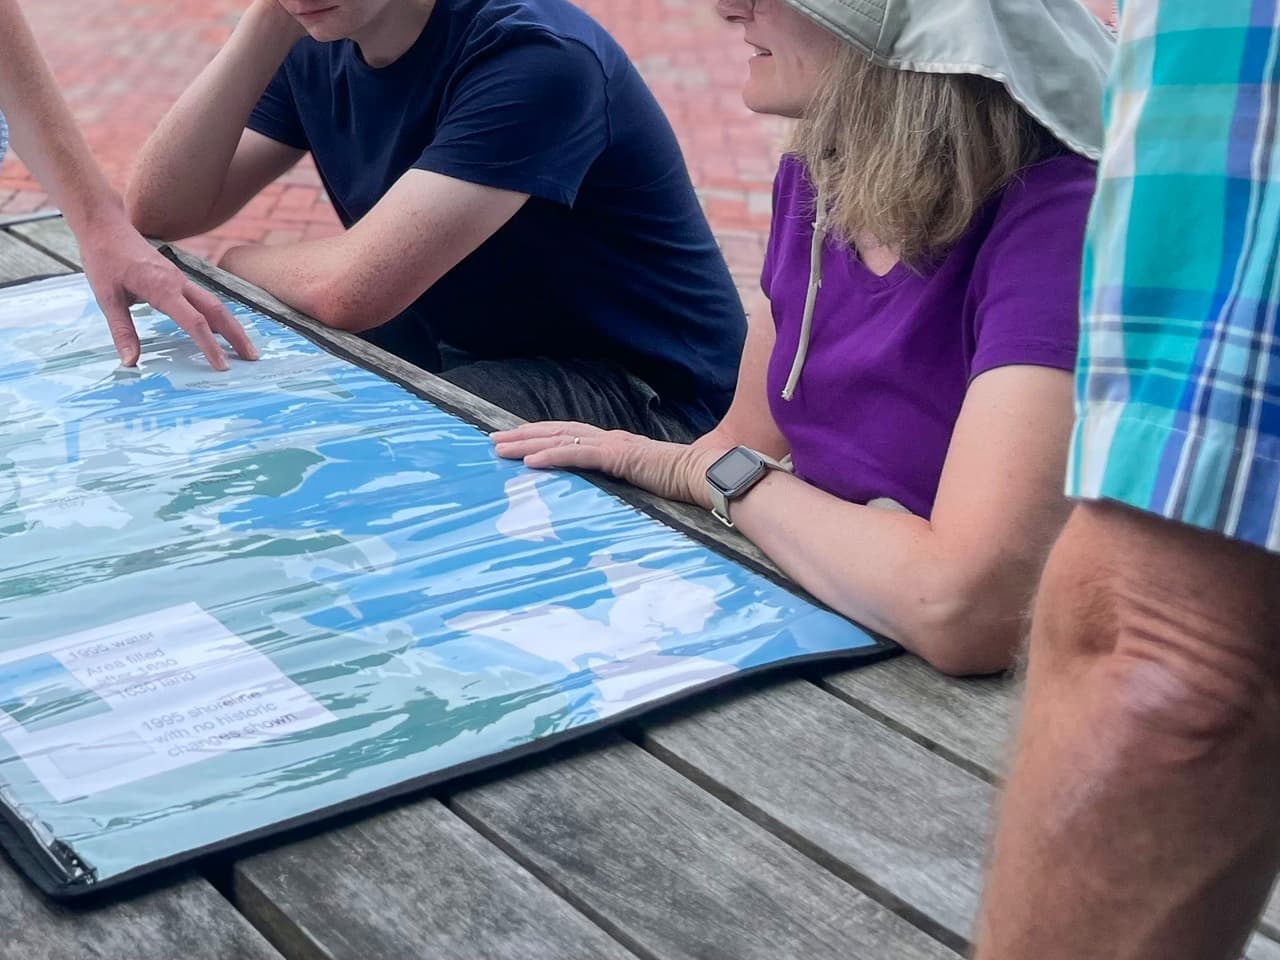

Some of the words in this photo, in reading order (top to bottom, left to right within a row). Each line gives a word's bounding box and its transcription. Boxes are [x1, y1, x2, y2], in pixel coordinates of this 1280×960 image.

[87, 659, 127, 677] Area
[125, 647, 166, 665] filled
[160, 670, 197, 688] land
[141, 710, 186, 732] 1995
[187, 690, 263, 718] shoreline
[153, 727, 191, 744] with
[192, 720, 215, 734] no
[215, 702, 278, 727] historic
[167, 729, 242, 758] changes
[243, 712, 297, 735] shown
